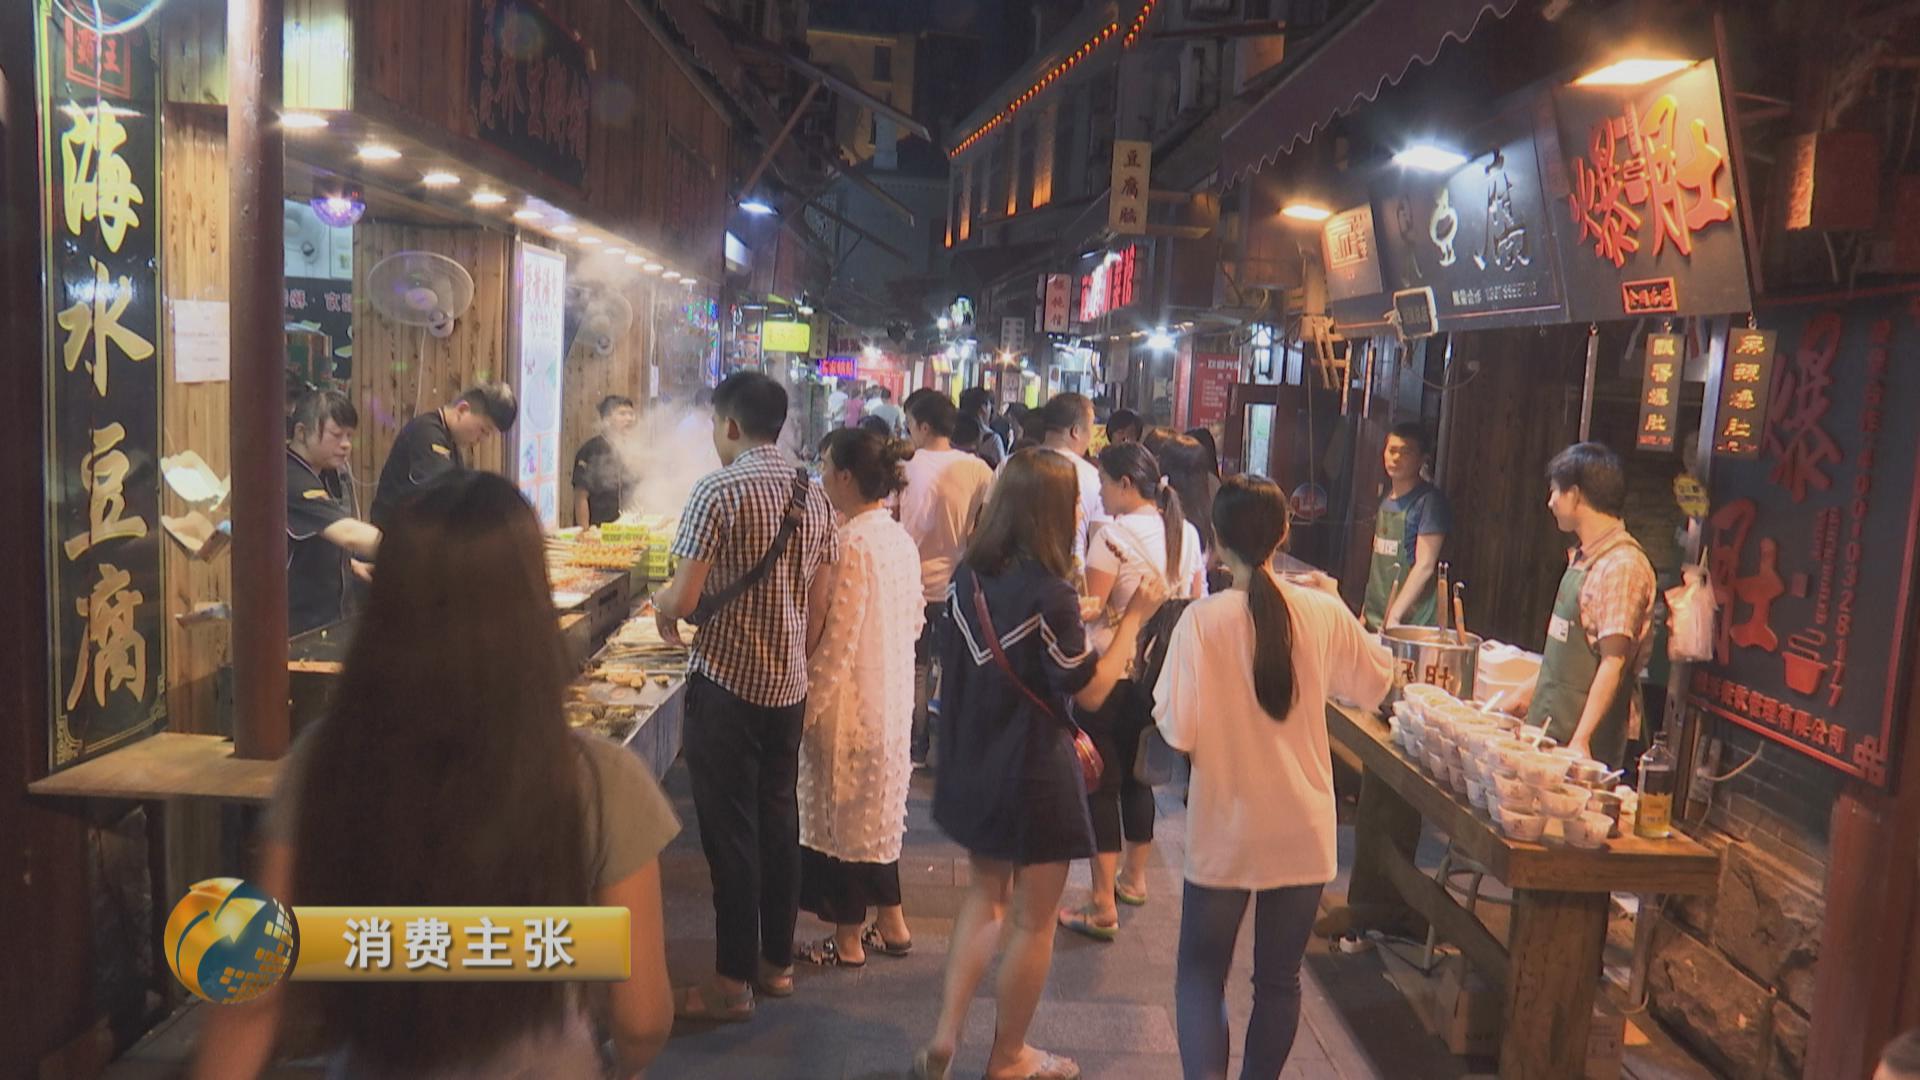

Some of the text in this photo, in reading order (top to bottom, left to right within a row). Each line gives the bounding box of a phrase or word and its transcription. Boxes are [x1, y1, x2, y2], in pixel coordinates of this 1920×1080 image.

[1568, 93, 1737, 269] 爆肚
[57, 100, 155, 712] 海水豆腐
